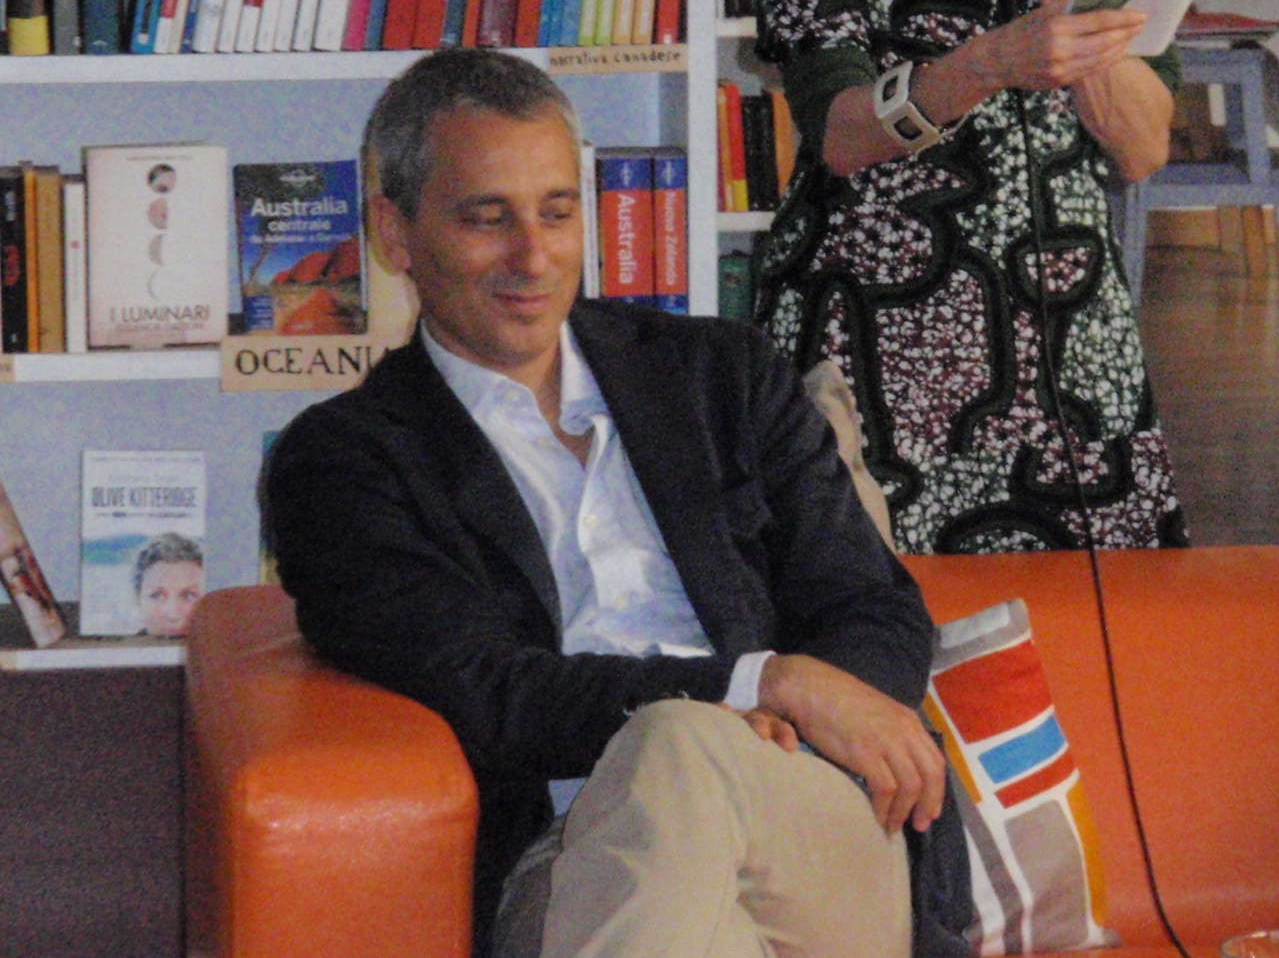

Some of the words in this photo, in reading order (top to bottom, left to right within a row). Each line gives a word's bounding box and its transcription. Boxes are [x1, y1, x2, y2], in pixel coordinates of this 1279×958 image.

[252, 198, 349, 217] Australia
[267, 219, 332, 233] centrale
[618, 193, 638, 285] Australia
[122, 304, 210, 323] LUMINARI
[236, 346, 390, 375] OCEANI
[92, 486, 126, 508] OLIVE
